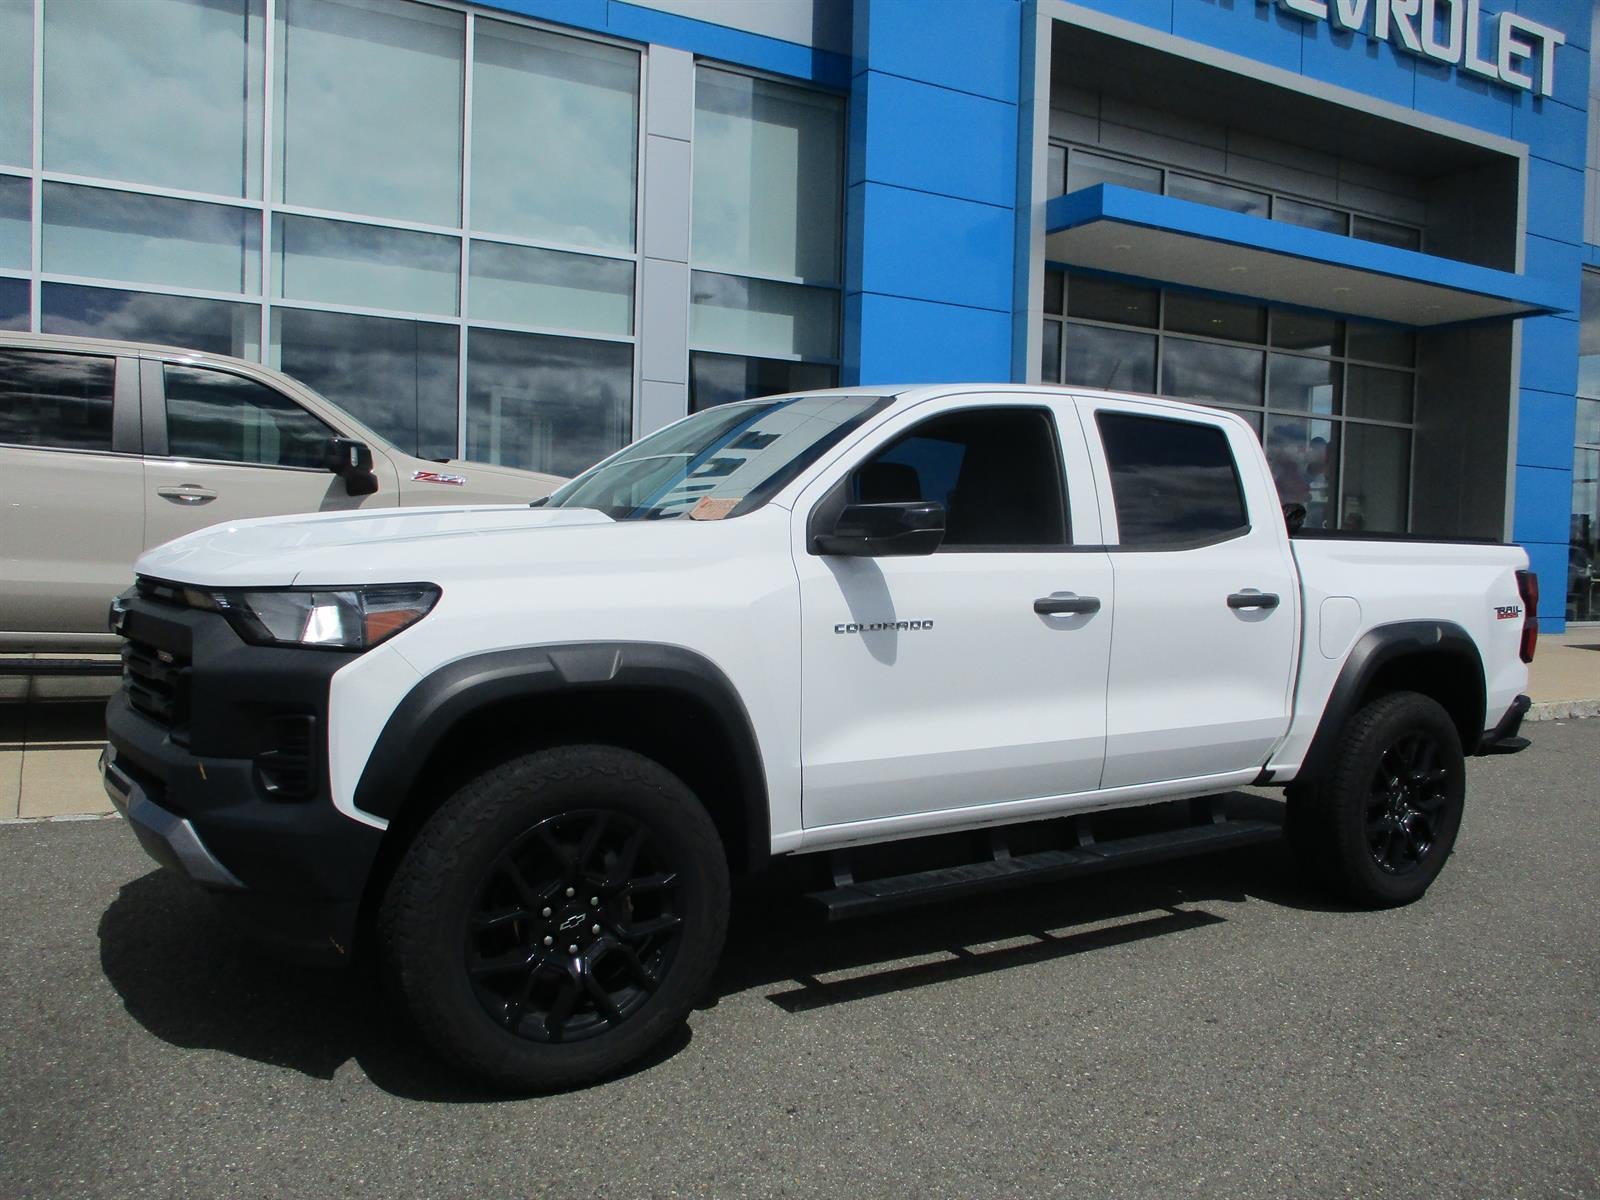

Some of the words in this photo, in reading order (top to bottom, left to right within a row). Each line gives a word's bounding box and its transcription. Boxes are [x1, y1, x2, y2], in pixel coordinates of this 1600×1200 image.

[1283, 0, 1566, 97] ROLET
[1494, 605, 1523, 614] TRAIL
[834, 620, 934, 634] COLORADO
